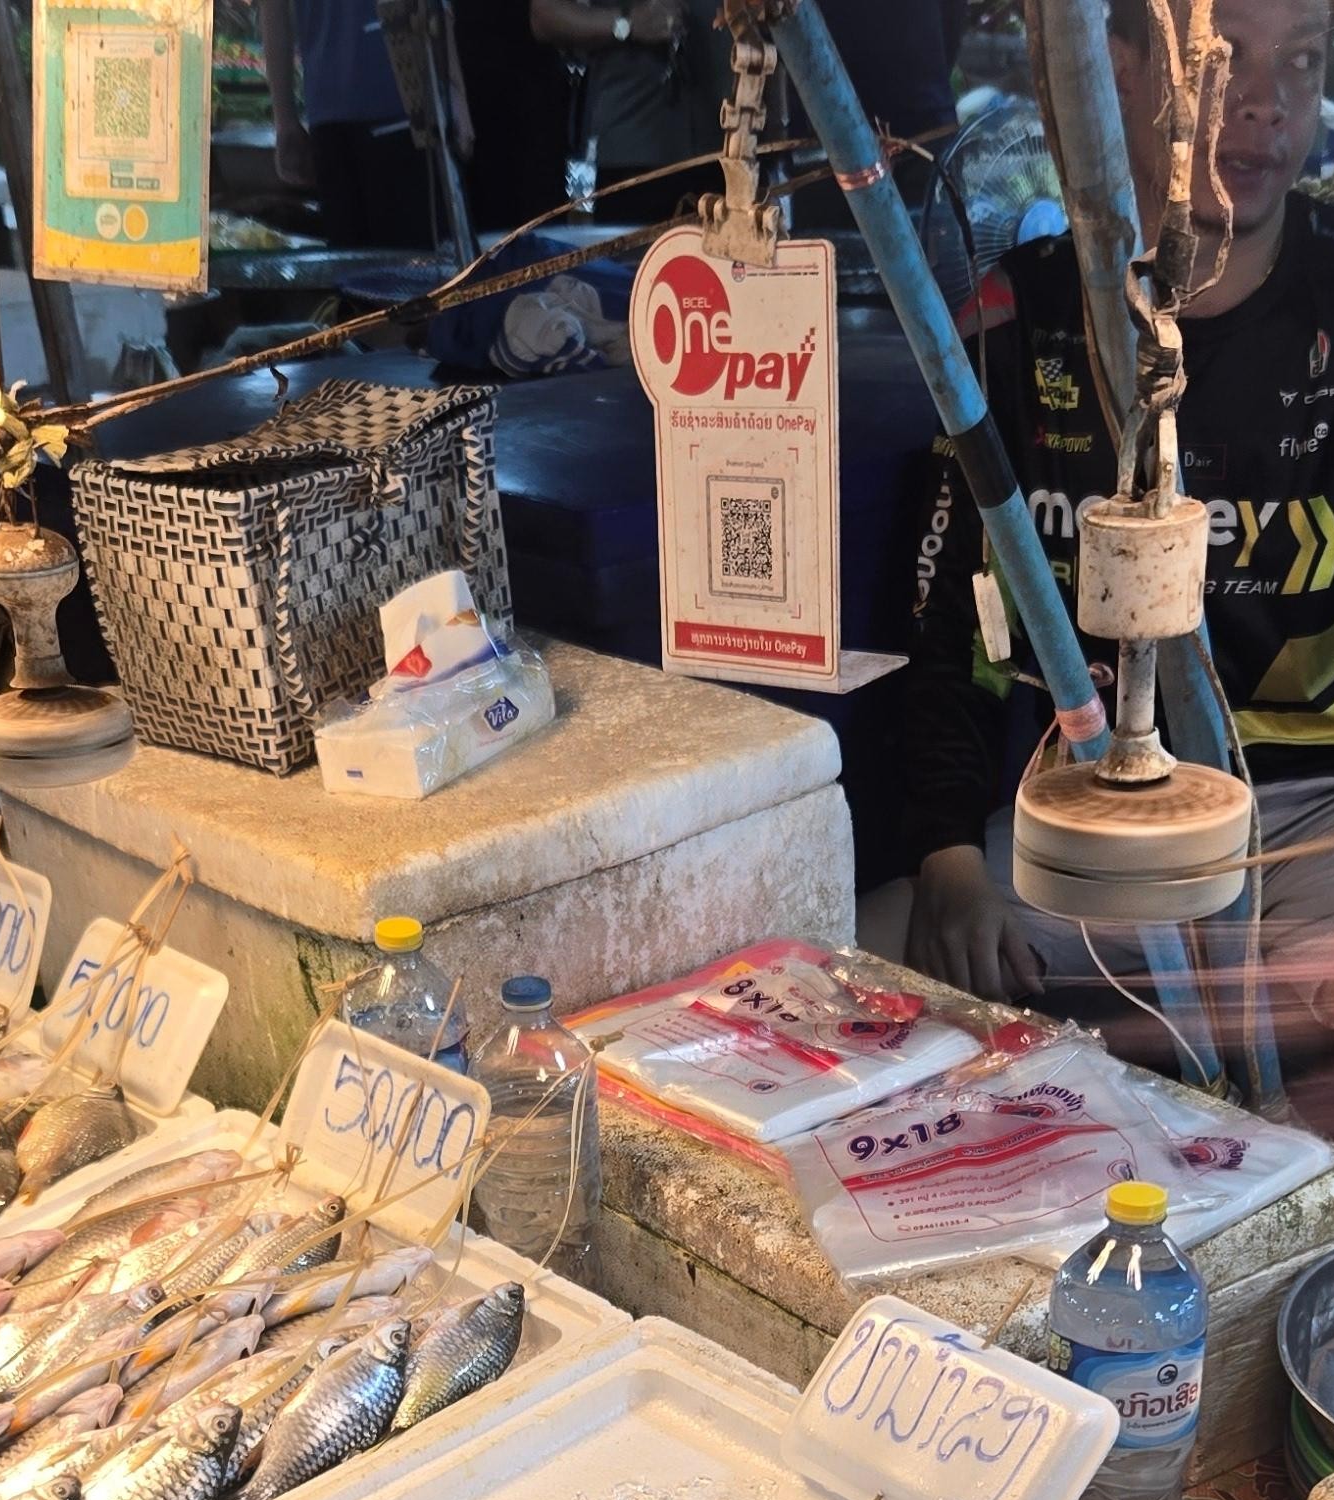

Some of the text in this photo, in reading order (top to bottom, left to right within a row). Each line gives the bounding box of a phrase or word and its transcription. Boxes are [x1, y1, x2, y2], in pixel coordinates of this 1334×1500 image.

[682, 297, 712, 309] BCEL
[647, 281, 733, 368] One
[724, 347, 815, 402] pay
[776, 414, 816, 436] OnePay
[1223, 579, 1279, 596] TEAM
[774, 638, 807, 659] OnePay
[848, 1112, 963, 1161] 9x18
